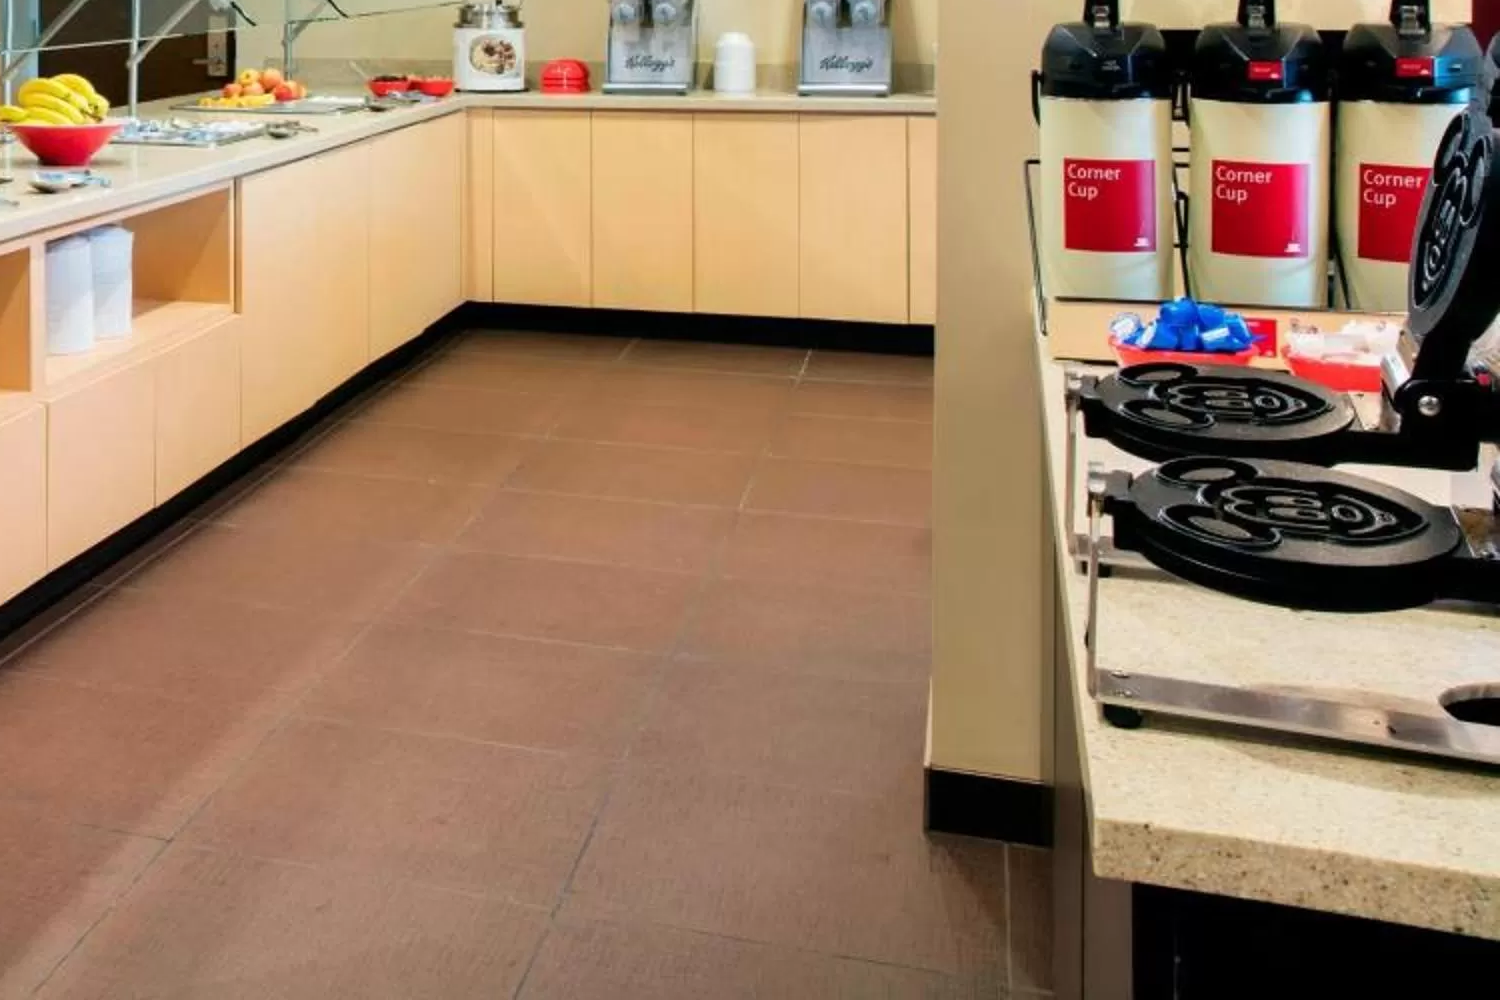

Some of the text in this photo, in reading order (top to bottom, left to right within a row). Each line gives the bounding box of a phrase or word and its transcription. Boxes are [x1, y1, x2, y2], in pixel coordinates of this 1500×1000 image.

[1067, 163, 1122, 181] Corner
[1215, 165, 1273, 184] Corner
[1363, 169, 1424, 189] Corner
[1067, 181, 1099, 201] Cup
[1215, 184, 1248, 206] Cup
[1363, 187, 1397, 209] Cup
